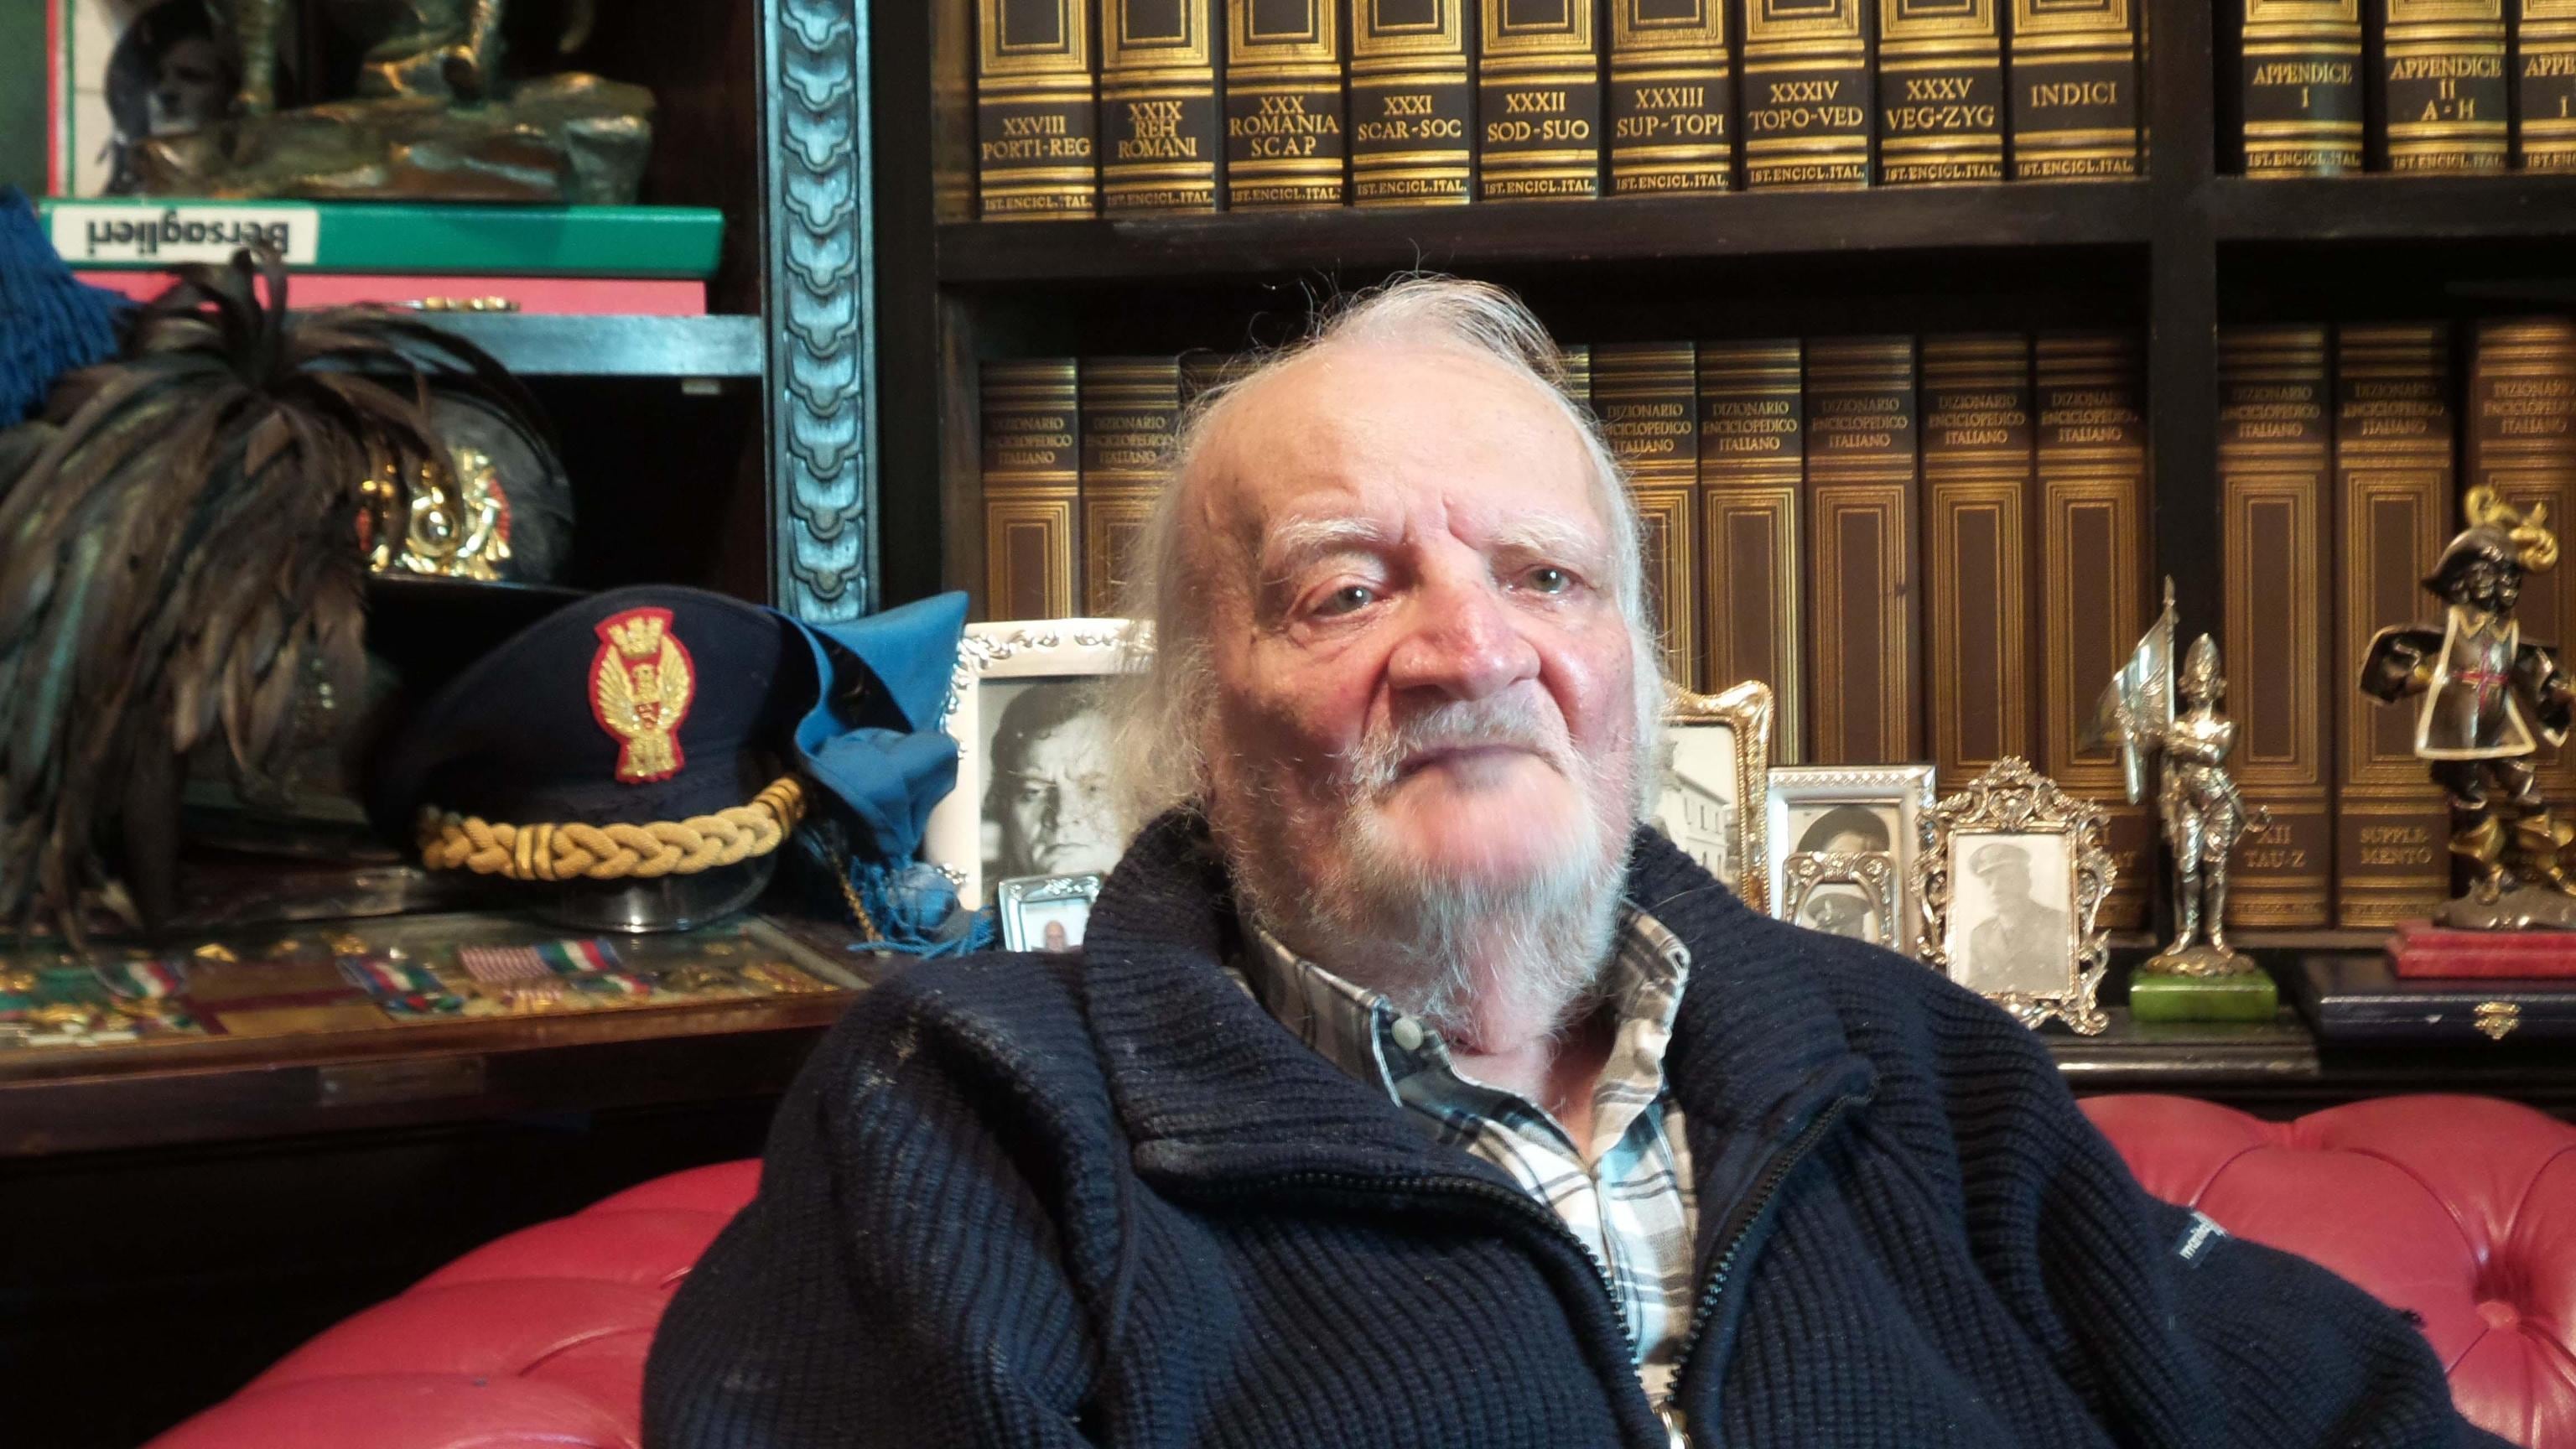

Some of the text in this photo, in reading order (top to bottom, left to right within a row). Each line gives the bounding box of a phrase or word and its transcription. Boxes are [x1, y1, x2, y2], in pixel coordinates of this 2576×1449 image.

[2254, 63, 2352, 84] APPENDICE
[2391, 55, 2501, 80] APPENDICE
[1635, 87, 1704, 109] XXXIII
[1770, 80, 1839, 102] XXXIV
[1907, 78, 1972, 100] XXXV
[2031, 81, 2117, 107] INDICI
[2440, 80, 2455, 100] II
[1128, 101, 1182, 121] XXIX
[1259, 96, 1304, 114] XXX
[1384, 96, 1431, 115] XXXI
[1506, 92, 1565, 112] XXXII
[1004, 116, 1065, 136] XXVIII
[1229, 113, 1338, 137] ROMANIA
[1617, 114, 1724, 137] SUP-TOPI
[1748, 106, 1863, 130] TOPO-VED
[1887, 105, 1995, 130] VEG-ZYG
[1358, 119, 1462, 140] SCAR-SOC
[1488, 120, 1589, 142] SOD-SUO
[982, 138, 1091, 160] PORTI-REG
[1119, 137, 1197, 158] ROMANI
[1251, 136, 1317, 156] SCAP
[89, 210, 289, 256] Bersaglieri
[1607, 403, 1683, 417] DIZIONARIO
[1713, 401, 1789, 416] DIZIONARIO
[1604, 422, 1691, 435] NCICLOPEDICO
[1703, 419, 1797, 434] ENCICLOPEDICO
[1613, 439, 1675, 453] ITALIANO
[1720, 437, 1780, 451] ITALIANO
[1830, 434, 1891, 448] ITALIANO
[1945, 430, 2008, 444] ITALIANO
